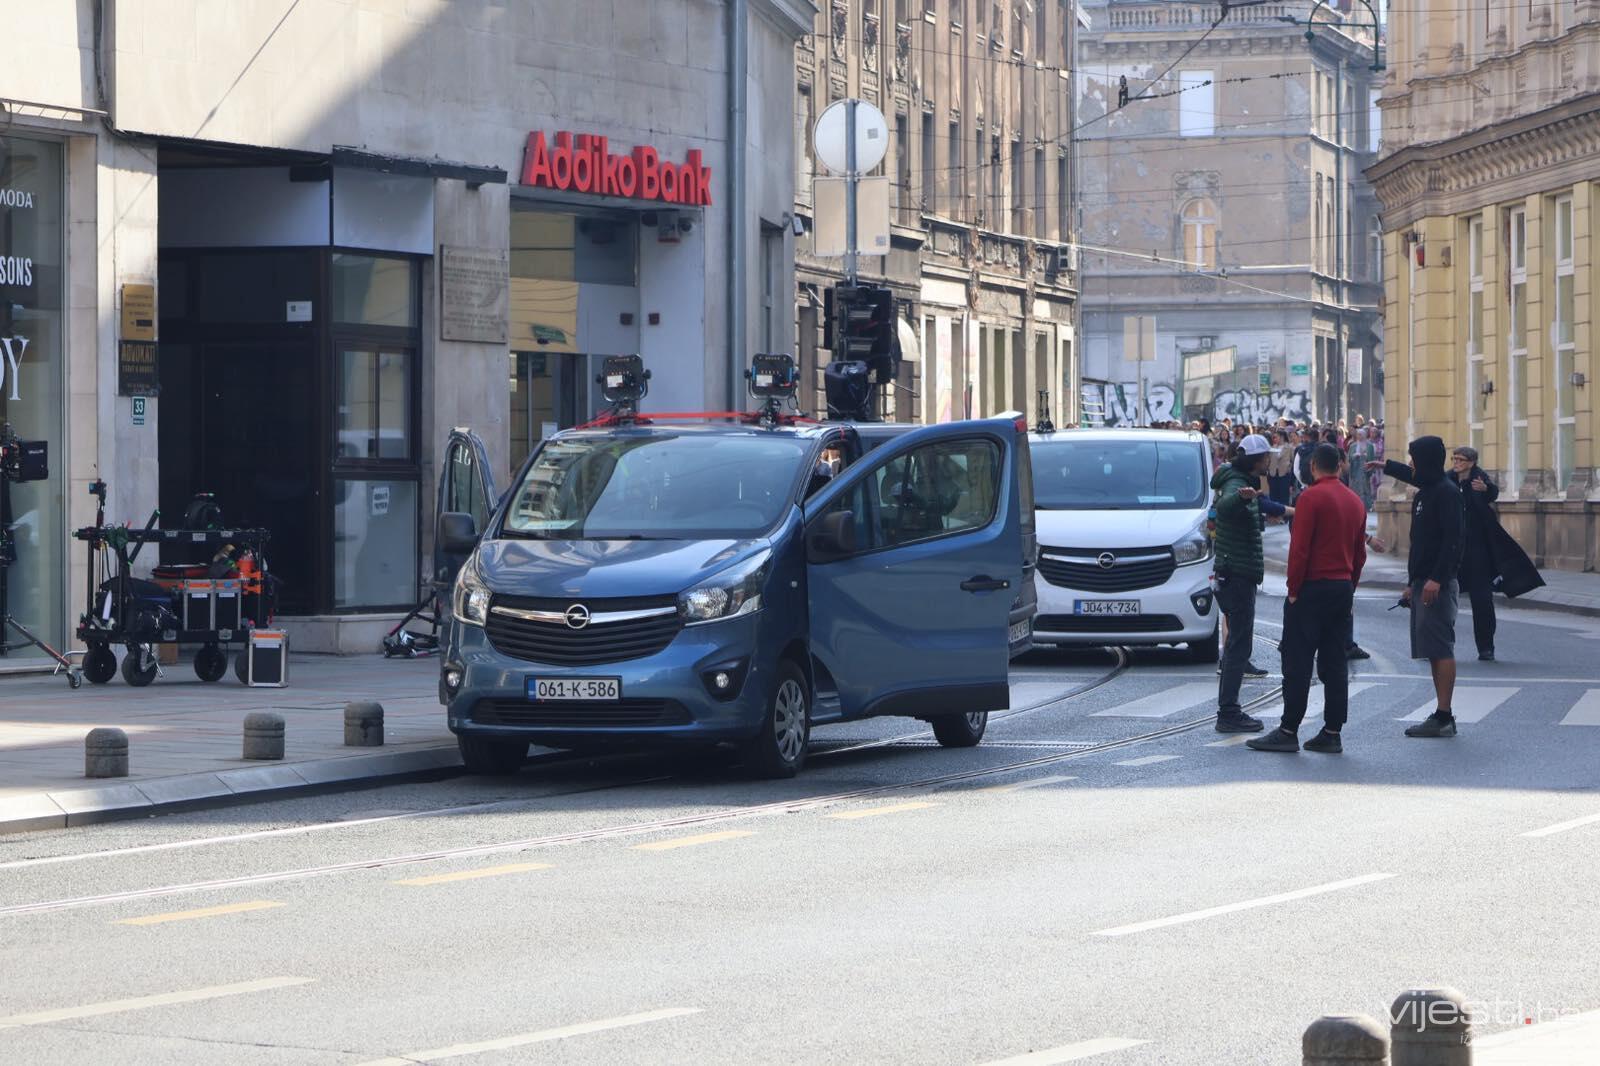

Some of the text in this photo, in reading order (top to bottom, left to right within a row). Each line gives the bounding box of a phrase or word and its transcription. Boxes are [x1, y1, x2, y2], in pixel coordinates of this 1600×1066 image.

[520, 130, 712, 206] Addiko Bank
[0, 337, 30, 401] Y
[135, 400, 144, 414] 33
[1082, 600, 1138, 613] J04-K-734
[538, 681, 616, 698] 061-K-586
